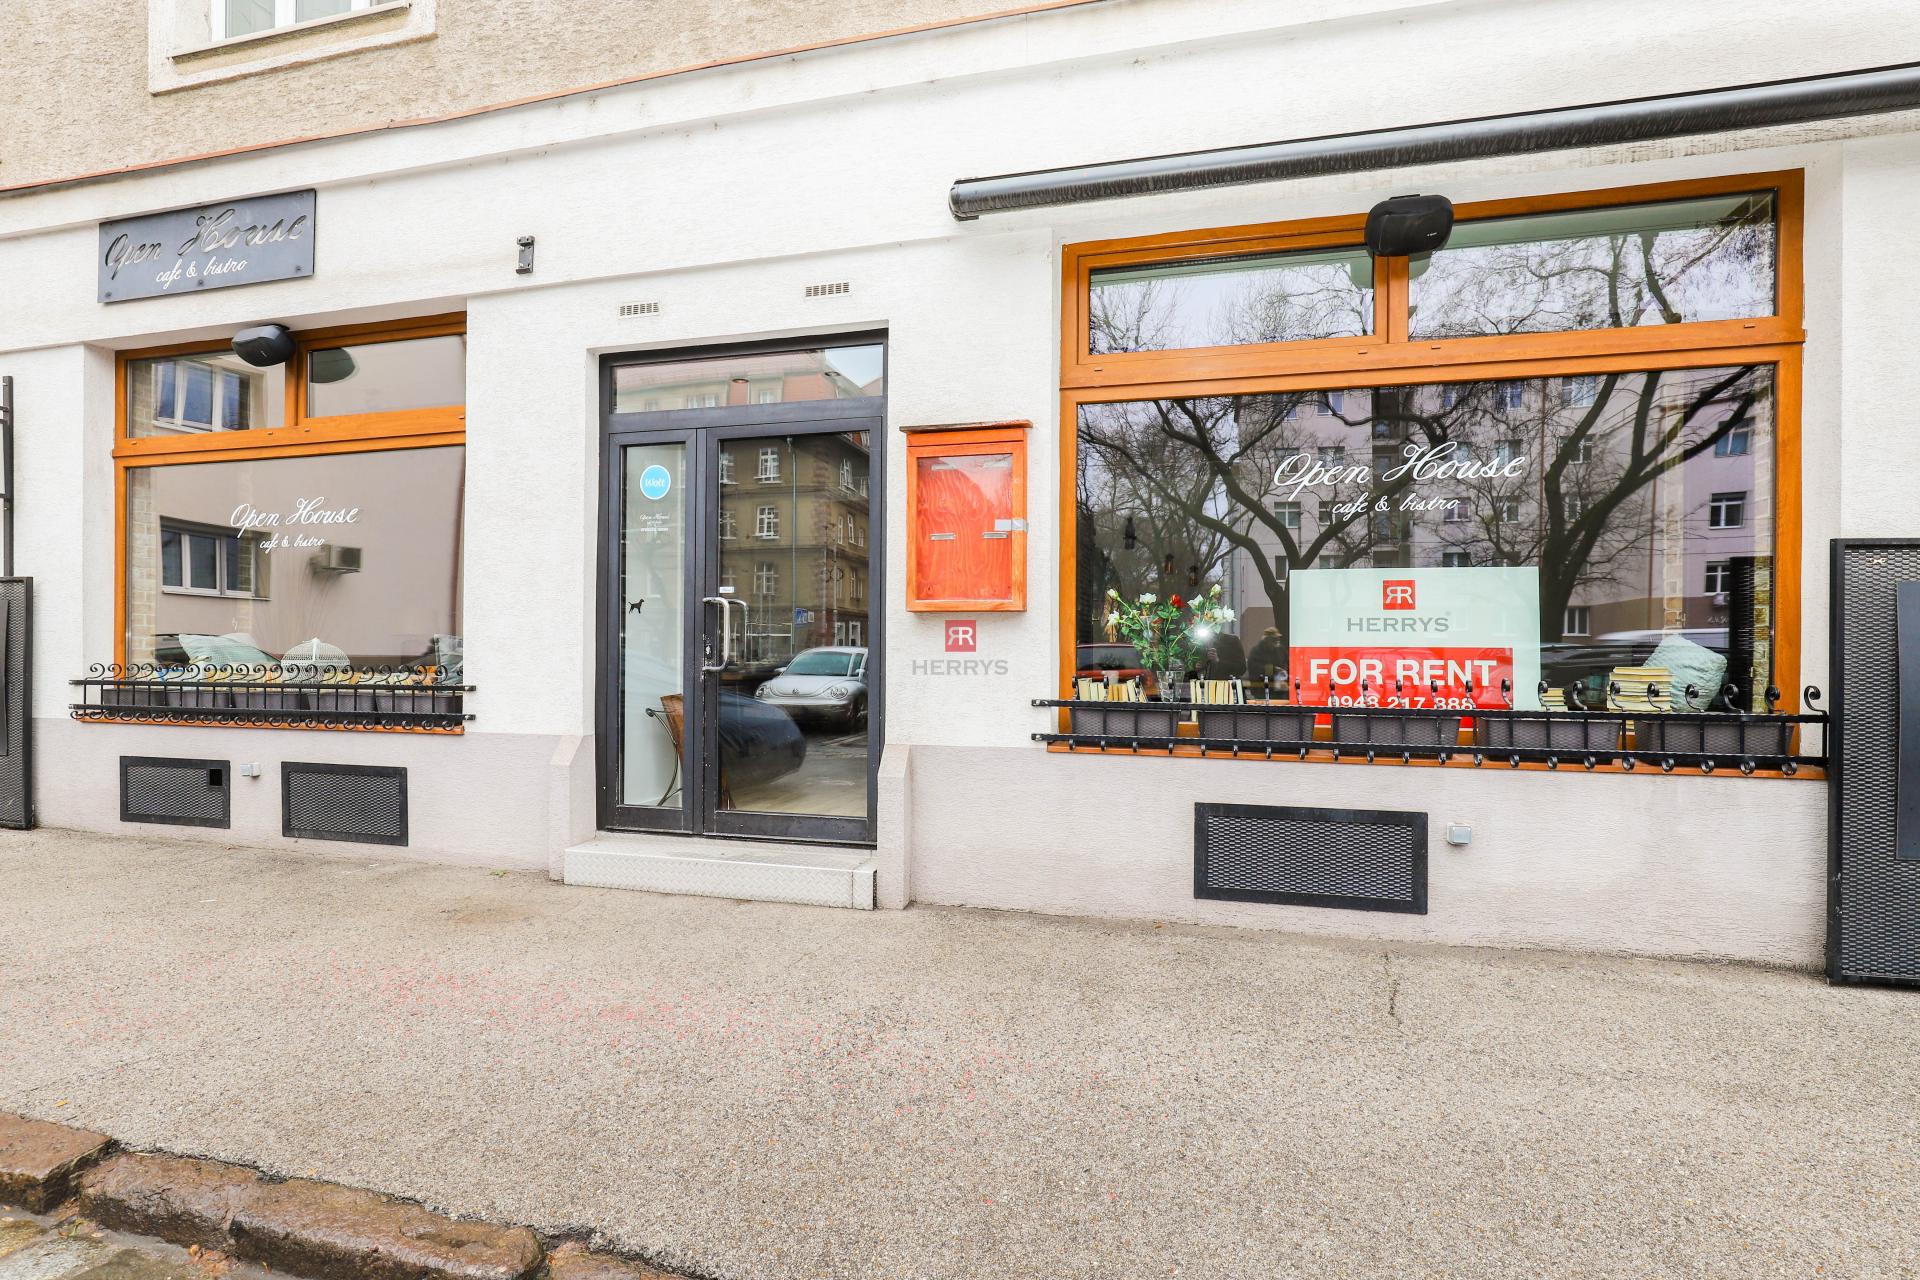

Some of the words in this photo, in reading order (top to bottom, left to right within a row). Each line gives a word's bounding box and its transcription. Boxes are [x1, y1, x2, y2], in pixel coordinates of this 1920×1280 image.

[105, 233, 162, 280] Open
[177, 208, 307, 256] House
[156, 259, 181, 289] cafe
[186, 261, 198, 278] &
[203, 256, 248, 276] bistro
[1273, 453, 1370, 501] Open
[1382, 441, 1526, 481] House
[231, 503, 279, 538] Open
[286, 496, 358, 524] House
[1332, 492, 1368, 521] cafe
[1375, 495, 1390, 512] &
[1399, 493, 1460, 511] bistro
[259, 533, 278, 553] cafe
[282, 536, 290, 547] &
[294, 534, 325, 547] bistro
[1347, 617, 1449, 632] HERRYS
[1310, 658, 1384, 685] FOR
[1396, 659, 1497, 686] RENT
